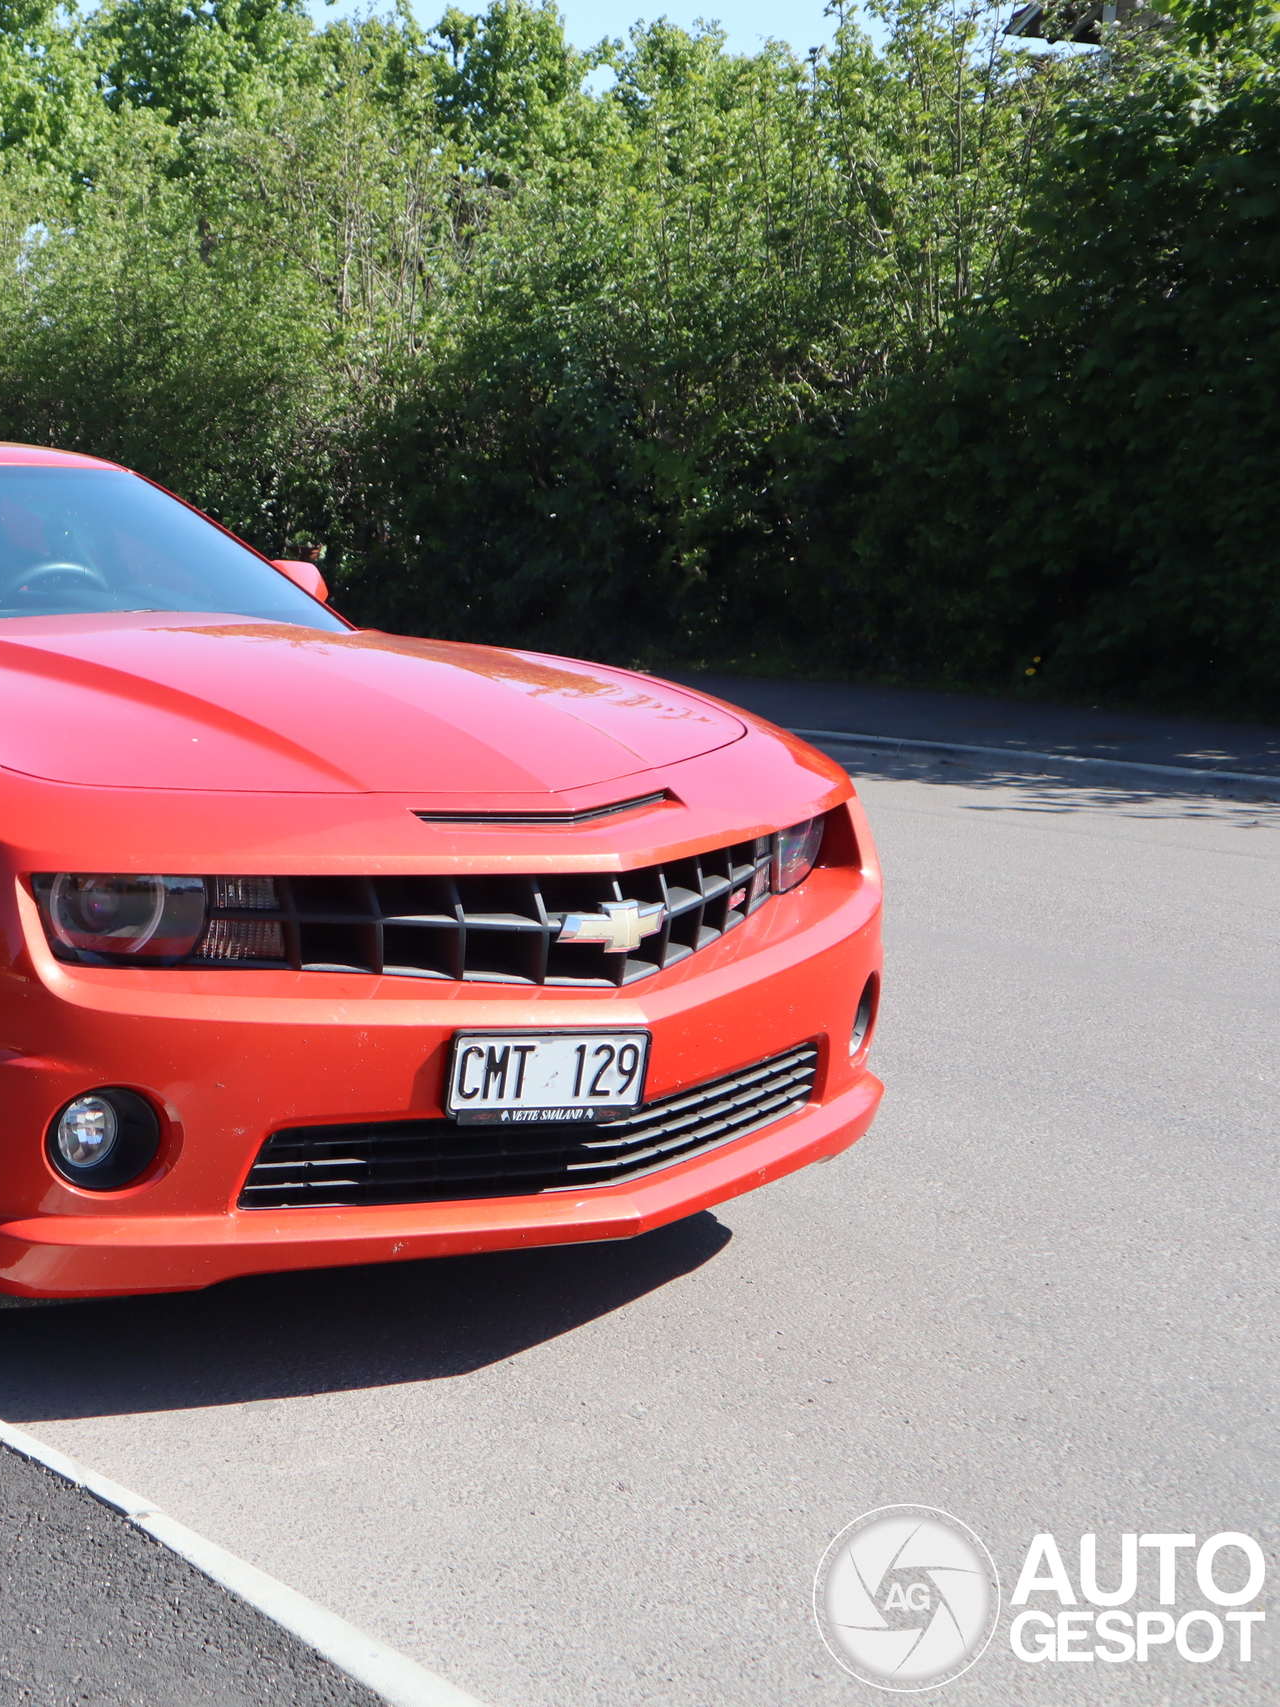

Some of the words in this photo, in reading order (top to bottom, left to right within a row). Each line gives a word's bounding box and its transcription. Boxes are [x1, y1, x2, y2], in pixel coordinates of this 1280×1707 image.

[458, 1045, 537, 1099] CMT
[574, 1043, 640, 1097] 129
[512, 1109, 539, 1122] VETTE
[540, 1107, 584, 1121] SMÅLAND
